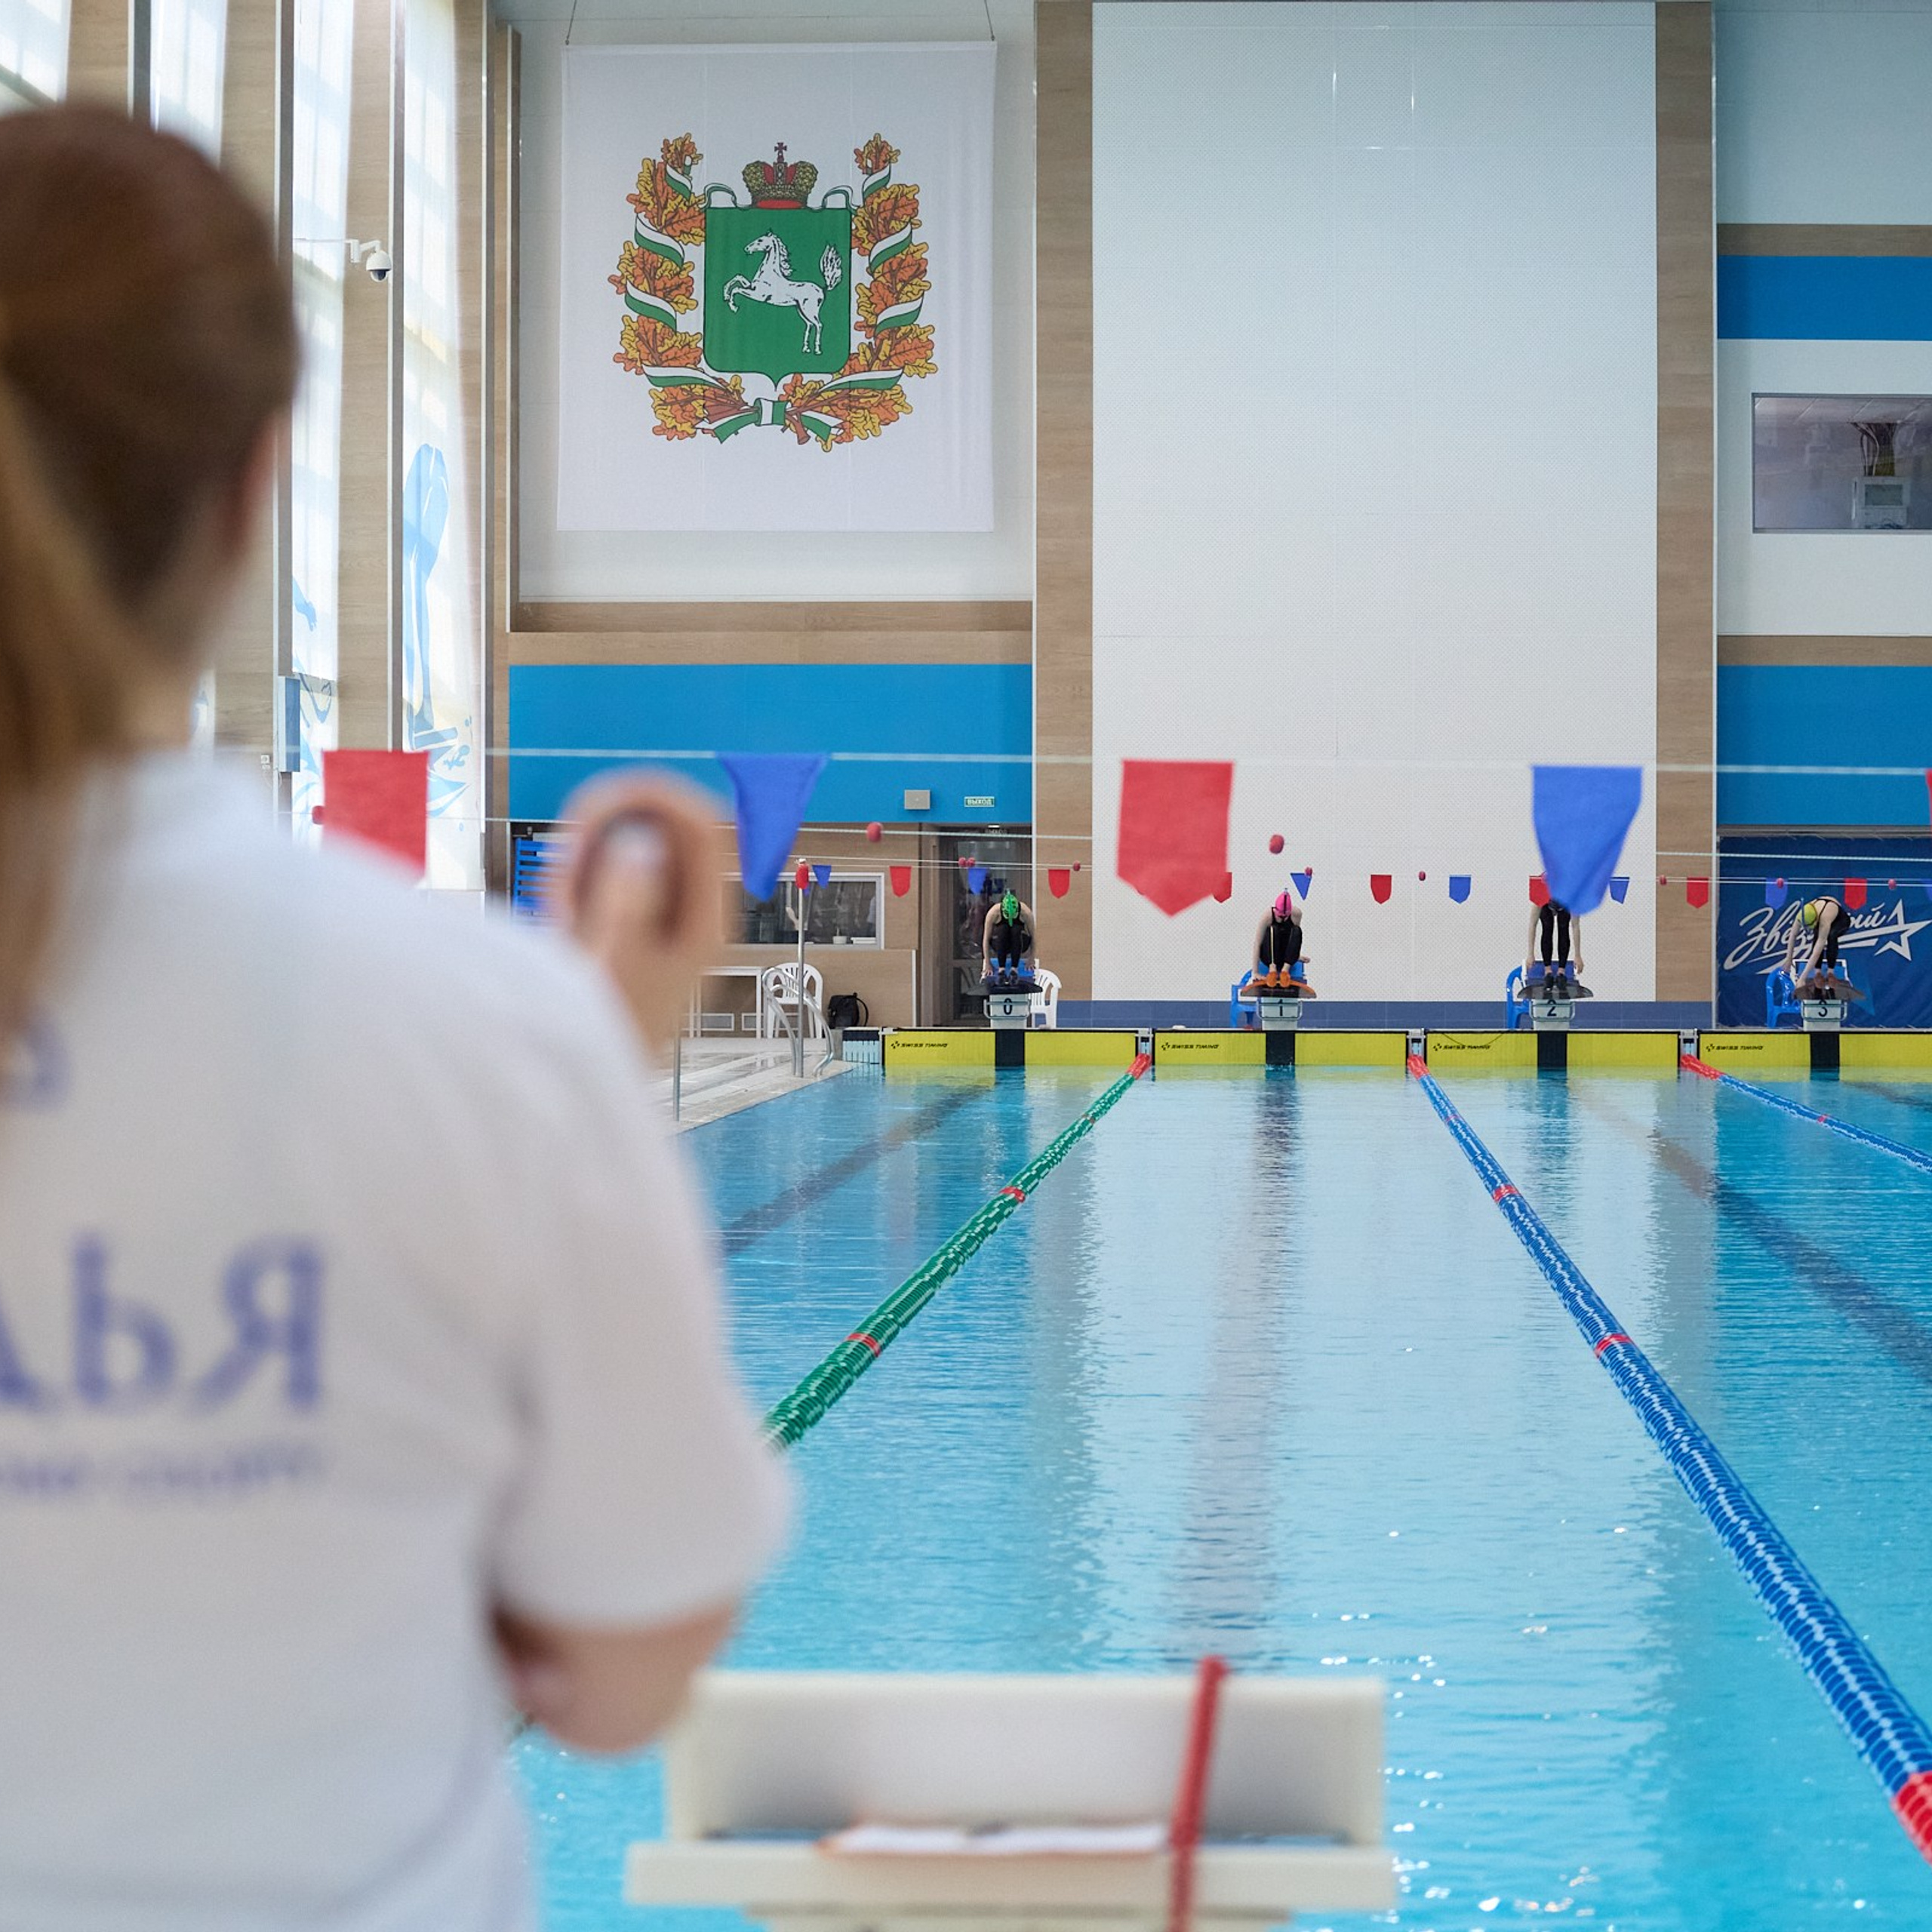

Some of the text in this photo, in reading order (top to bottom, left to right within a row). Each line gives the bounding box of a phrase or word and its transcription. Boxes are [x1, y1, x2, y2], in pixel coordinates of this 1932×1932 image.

[1003, 997, 1014, 1015] 0
[1277, 998, 1284, 1017] 1
[1546, 999, 1557, 1017] 2
[1818, 998, 1828, 1017] 3
